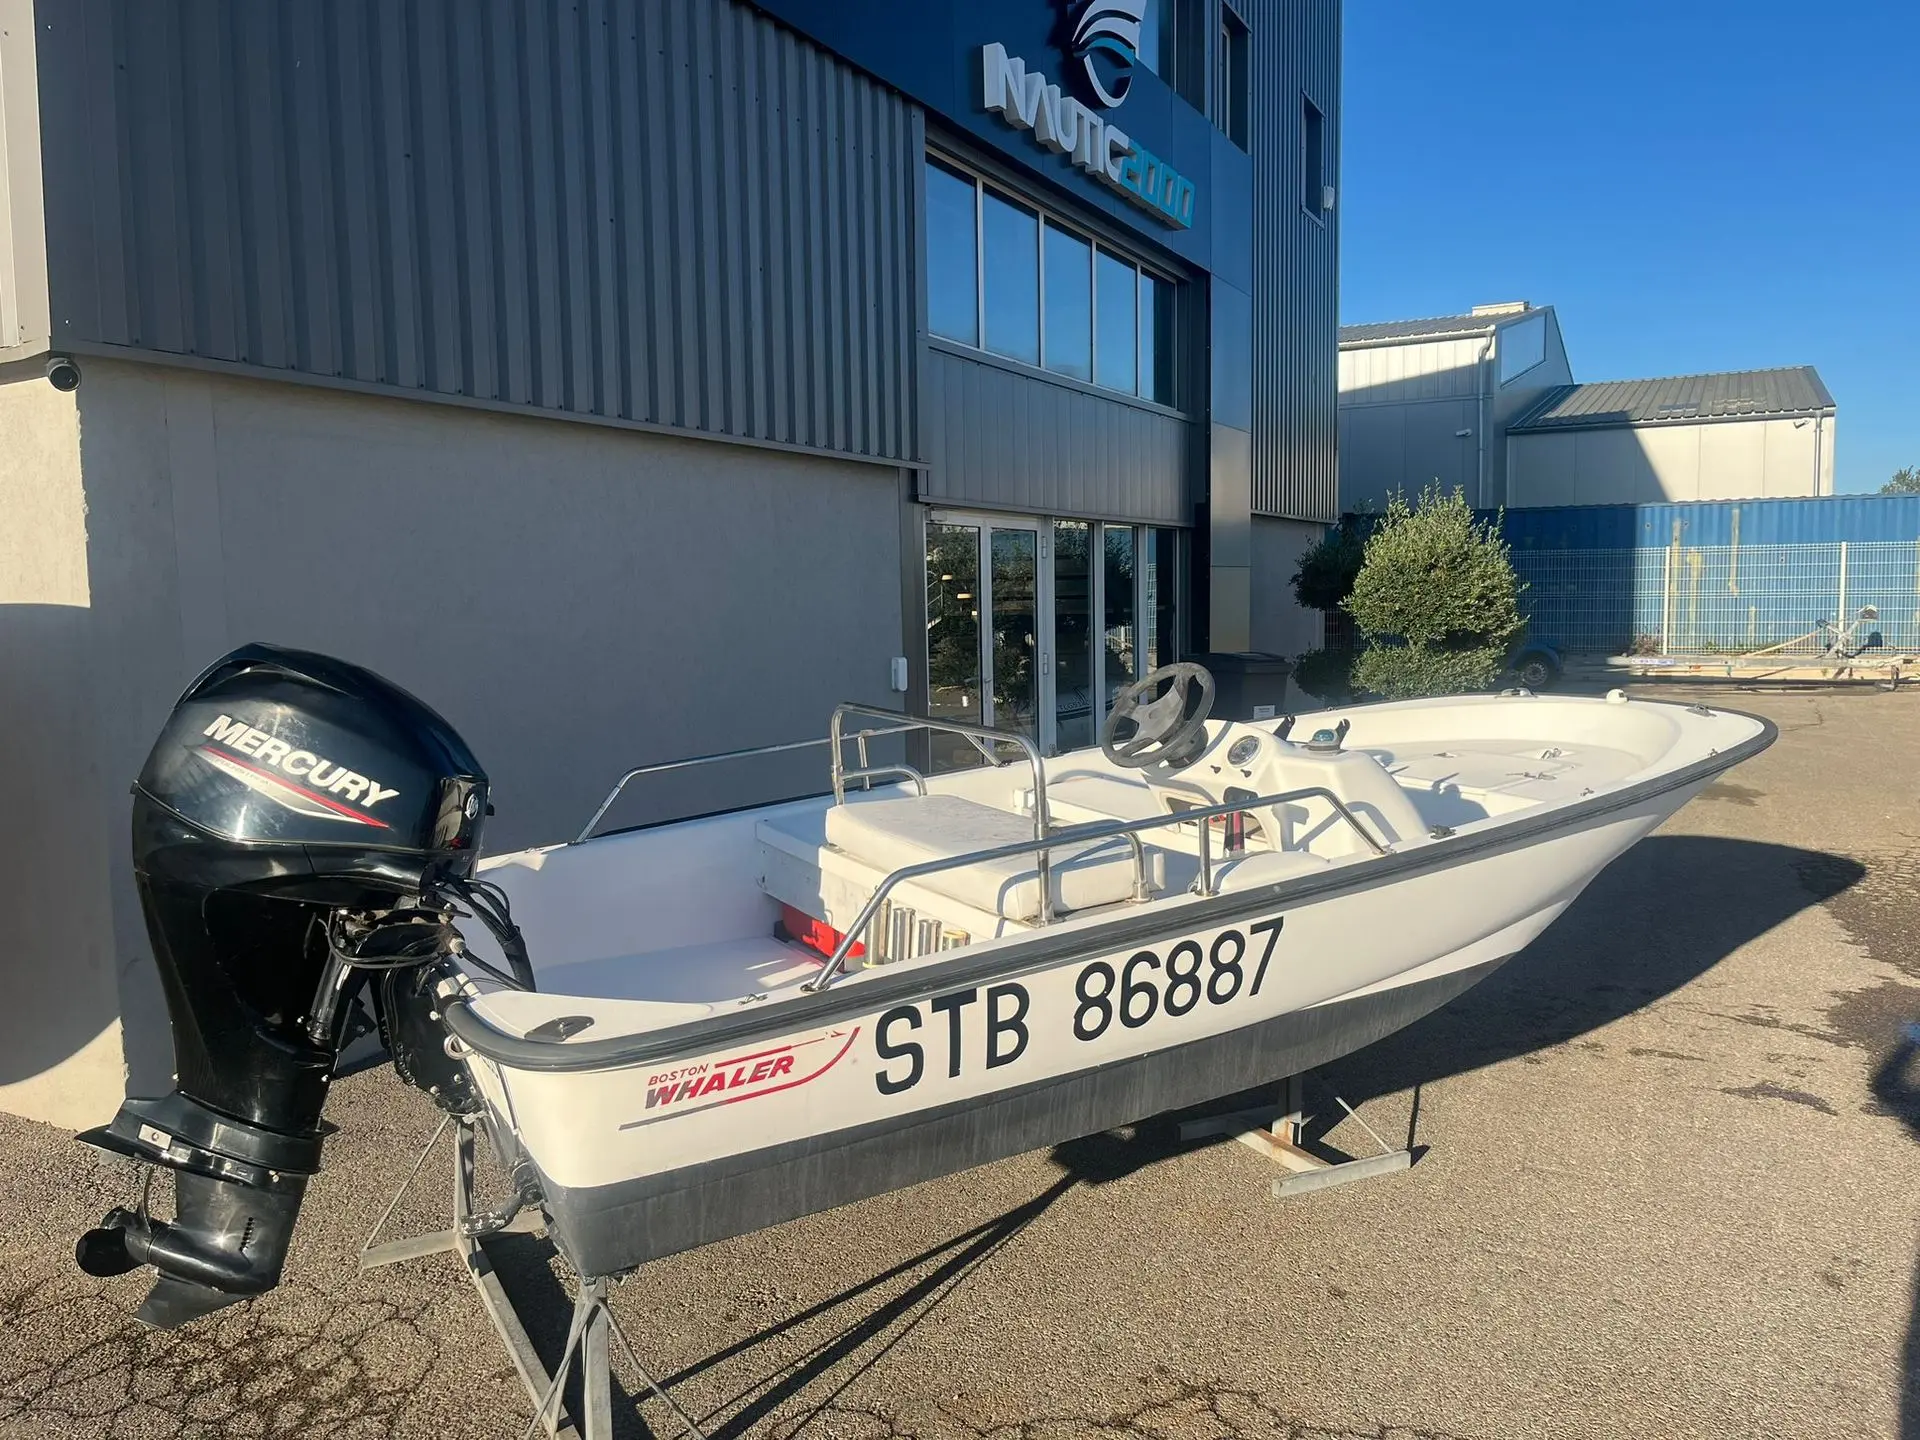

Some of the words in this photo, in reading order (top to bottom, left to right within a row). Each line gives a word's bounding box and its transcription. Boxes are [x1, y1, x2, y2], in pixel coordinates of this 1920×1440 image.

[204, 714, 399, 807] MERCURY
[875, 982, 1028, 1095] STB
[1073, 916, 1284, 1041] 86887
[645, 1055, 795, 1109] WHALER
[648, 1063, 709, 1086] BOSTON
